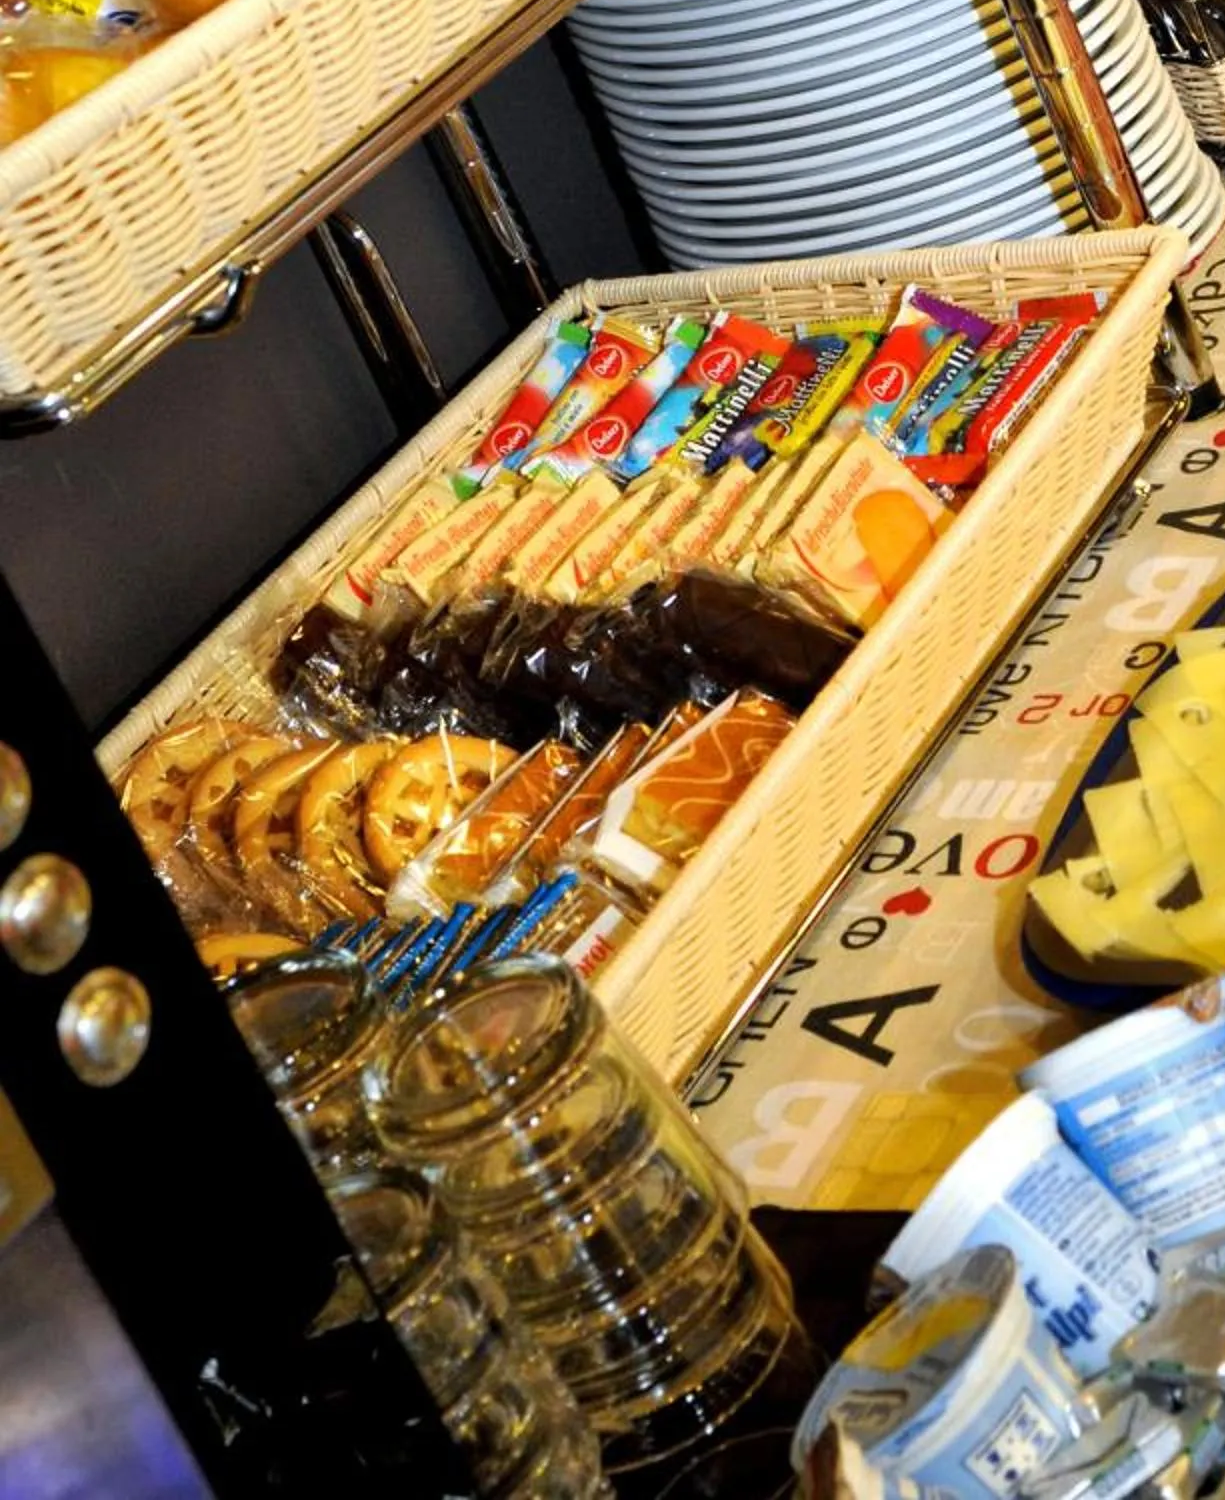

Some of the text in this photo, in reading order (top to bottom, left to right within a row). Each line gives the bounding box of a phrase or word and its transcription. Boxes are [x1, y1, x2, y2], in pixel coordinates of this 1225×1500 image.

[686, 356, 772, 467] Mattinelli
[960, 315, 1048, 420] Mattinelli
[863, 829, 1041, 880] ove
[801, 982, 943, 1068] A
